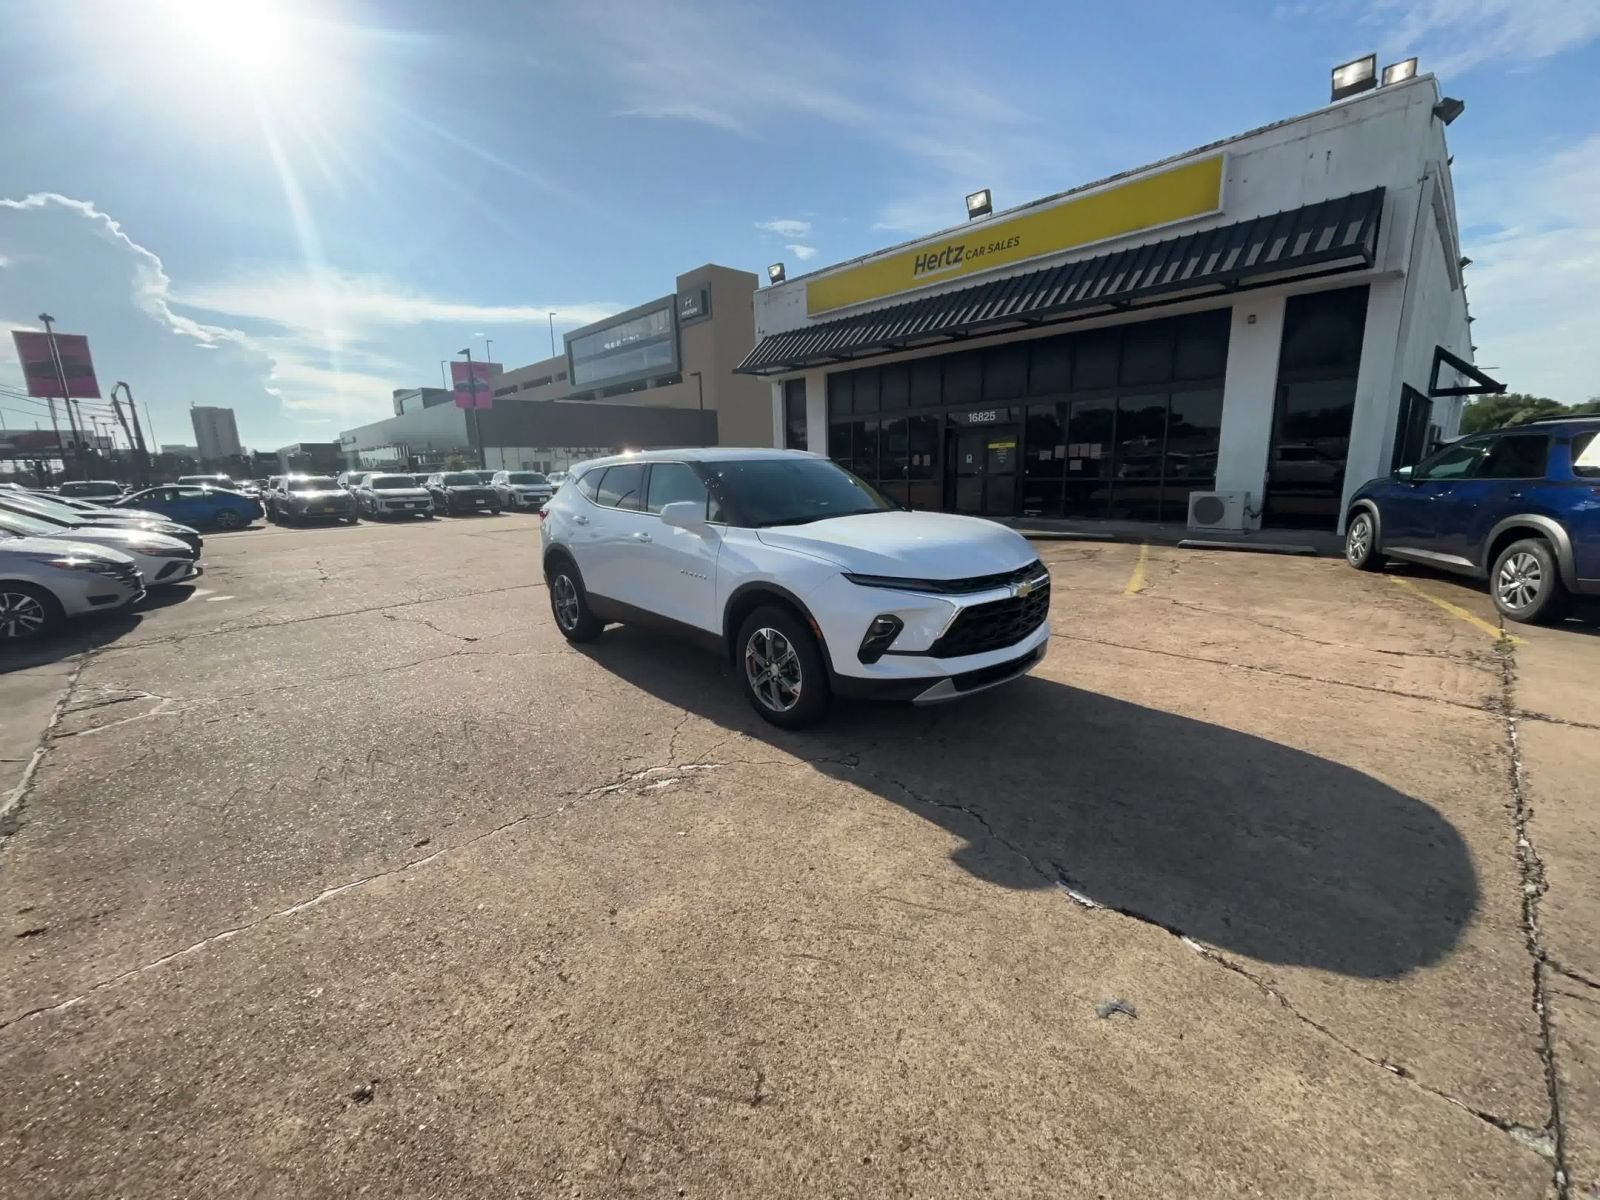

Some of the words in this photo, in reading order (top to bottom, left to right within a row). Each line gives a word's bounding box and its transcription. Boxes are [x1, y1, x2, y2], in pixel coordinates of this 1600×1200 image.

[914, 245, 965, 275] Hertz
[965, 246, 985, 260] CAR
[987, 236, 1020, 253] SALES
[968, 411, 996, 423] 16825
